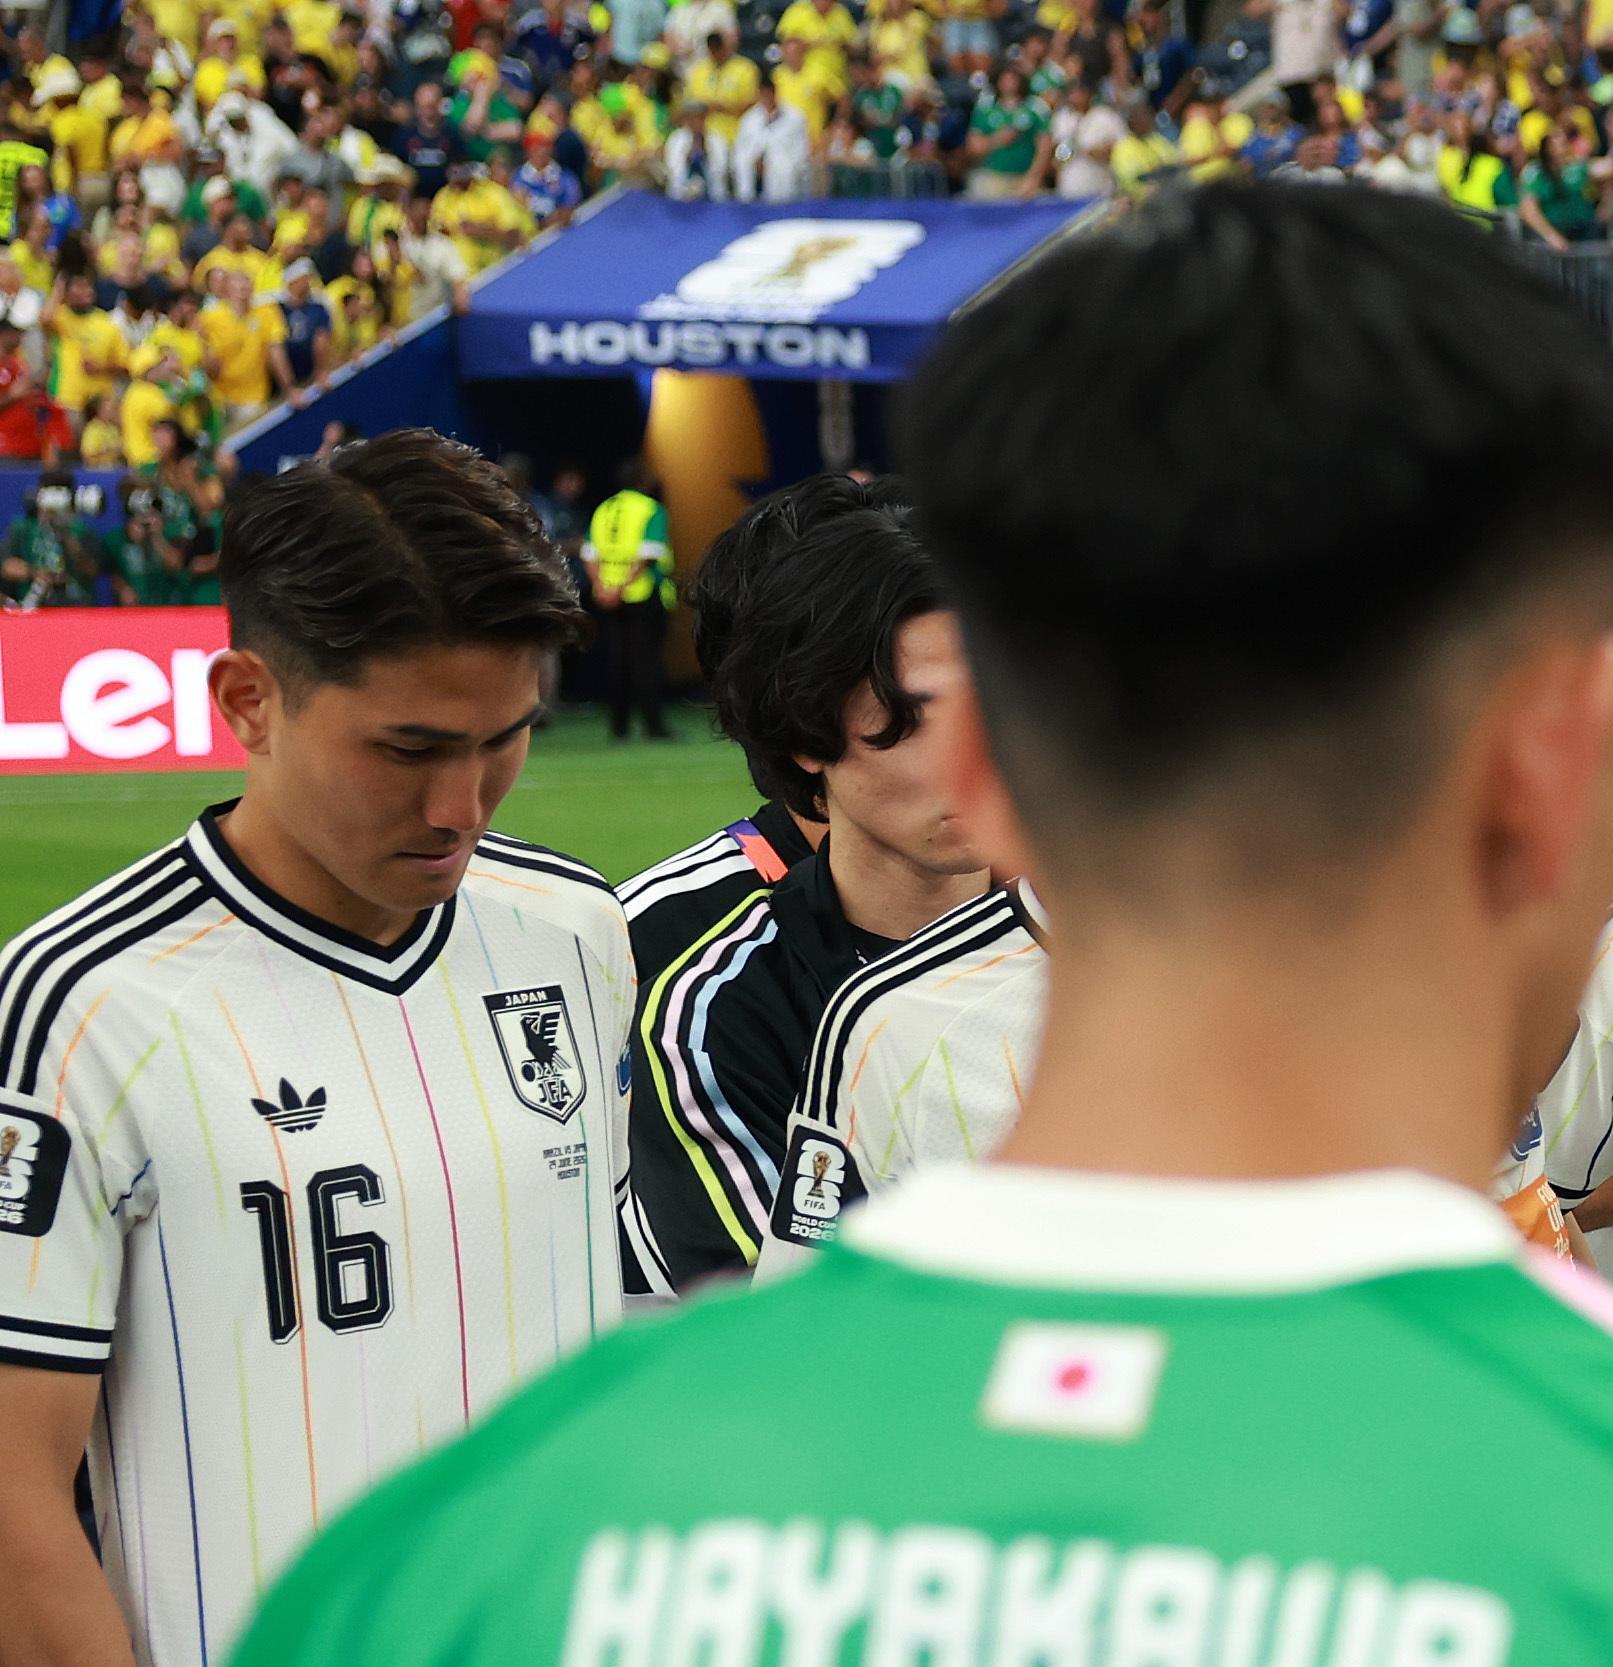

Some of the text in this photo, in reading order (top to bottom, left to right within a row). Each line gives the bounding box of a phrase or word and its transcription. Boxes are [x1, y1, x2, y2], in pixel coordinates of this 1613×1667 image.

[529, 320, 871, 371] HOUSTON
[505, 991, 548, 1006] JAPAN
[537, 1079, 574, 1104] JFA
[803, 1199, 826, 1211] FIFA
[791, 1213, 818, 1227] WORLD
[789, 1222, 835, 1241] 2026
[239, 1163, 395, 1345] 16
